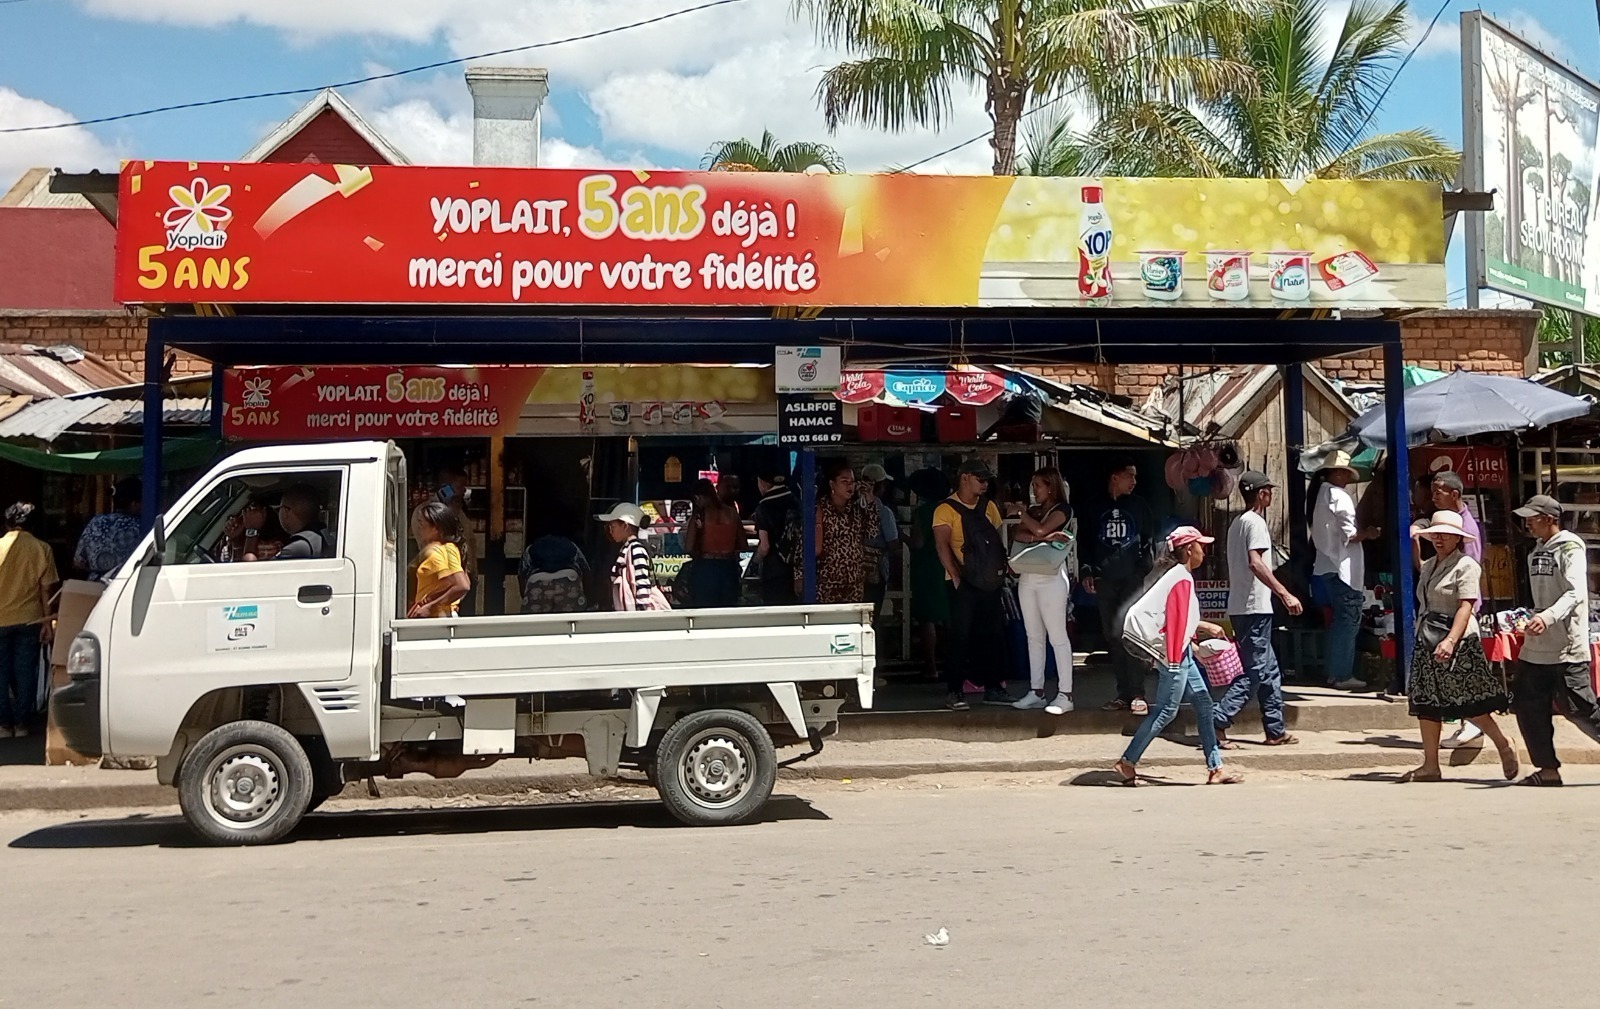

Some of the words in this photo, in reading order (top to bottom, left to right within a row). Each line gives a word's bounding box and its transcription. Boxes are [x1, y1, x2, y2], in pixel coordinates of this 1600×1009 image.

[430, 196, 571, 238] YOPLAIT,
[711, 200, 777, 247] déjà
[785, 201, 796, 239] !
[1545, 197, 1584, 233] BUREAU
[169, 233, 225, 249] Yoplait
[1085, 230, 1111, 255] YOP
[1520, 220, 1583, 264] SHOWROOM
[137, 245, 168, 289] 5
[173, 256, 250, 290] ANS
[408, 252, 503, 290] merci
[512, 259, 593, 300] pour
[599, 253, 692, 290] votre
[699, 252, 817, 291] fidélité
[840, 372, 864, 384] World
[847, 381, 872, 390] Cola
[892, 378, 938, 394] Caprice
[959, 373, 985, 386] World
[449, 385, 481, 406] déjà
[967, 383, 993, 393] Cola
[231, 406, 245, 425] 5
[247, 410, 280, 425] ANS
[306, 410, 350, 427] merci
[354, 412, 391, 431] pour
[396, 410, 439, 426] votre
[441, 407, 499, 426] fidélité
[789, 417, 833, 427] HAMAC
[781, 435, 797, 443] 032
[1467, 457, 1504, 471] airtel
[1106, 522, 1127, 538] 20
[1198, 592, 1227, 600] COPIE
